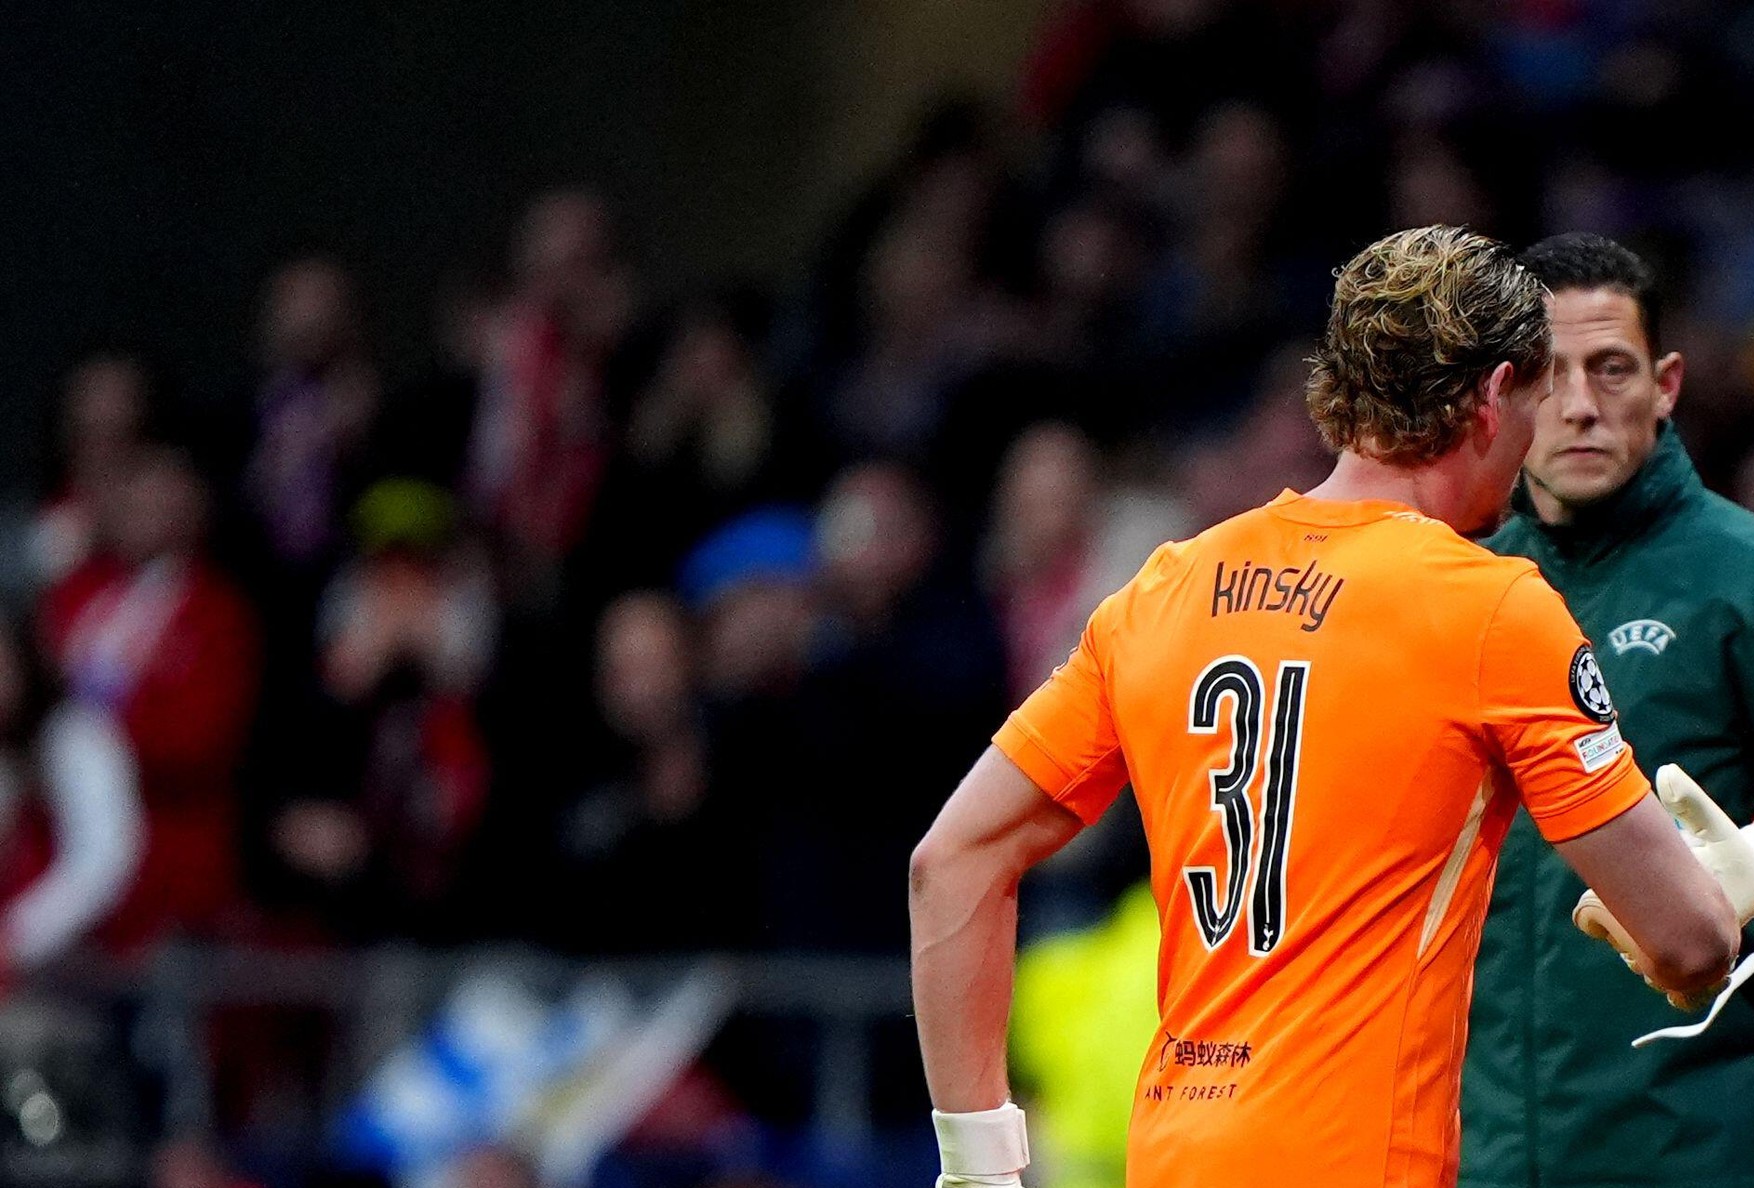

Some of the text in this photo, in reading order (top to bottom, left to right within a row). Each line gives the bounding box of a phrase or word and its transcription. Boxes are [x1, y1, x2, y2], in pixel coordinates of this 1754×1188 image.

[1609, 621, 1674, 654] UEFA
[1183, 654, 1311, 957] 31
[1144, 1083, 1237, 1101] ANT FOREST
